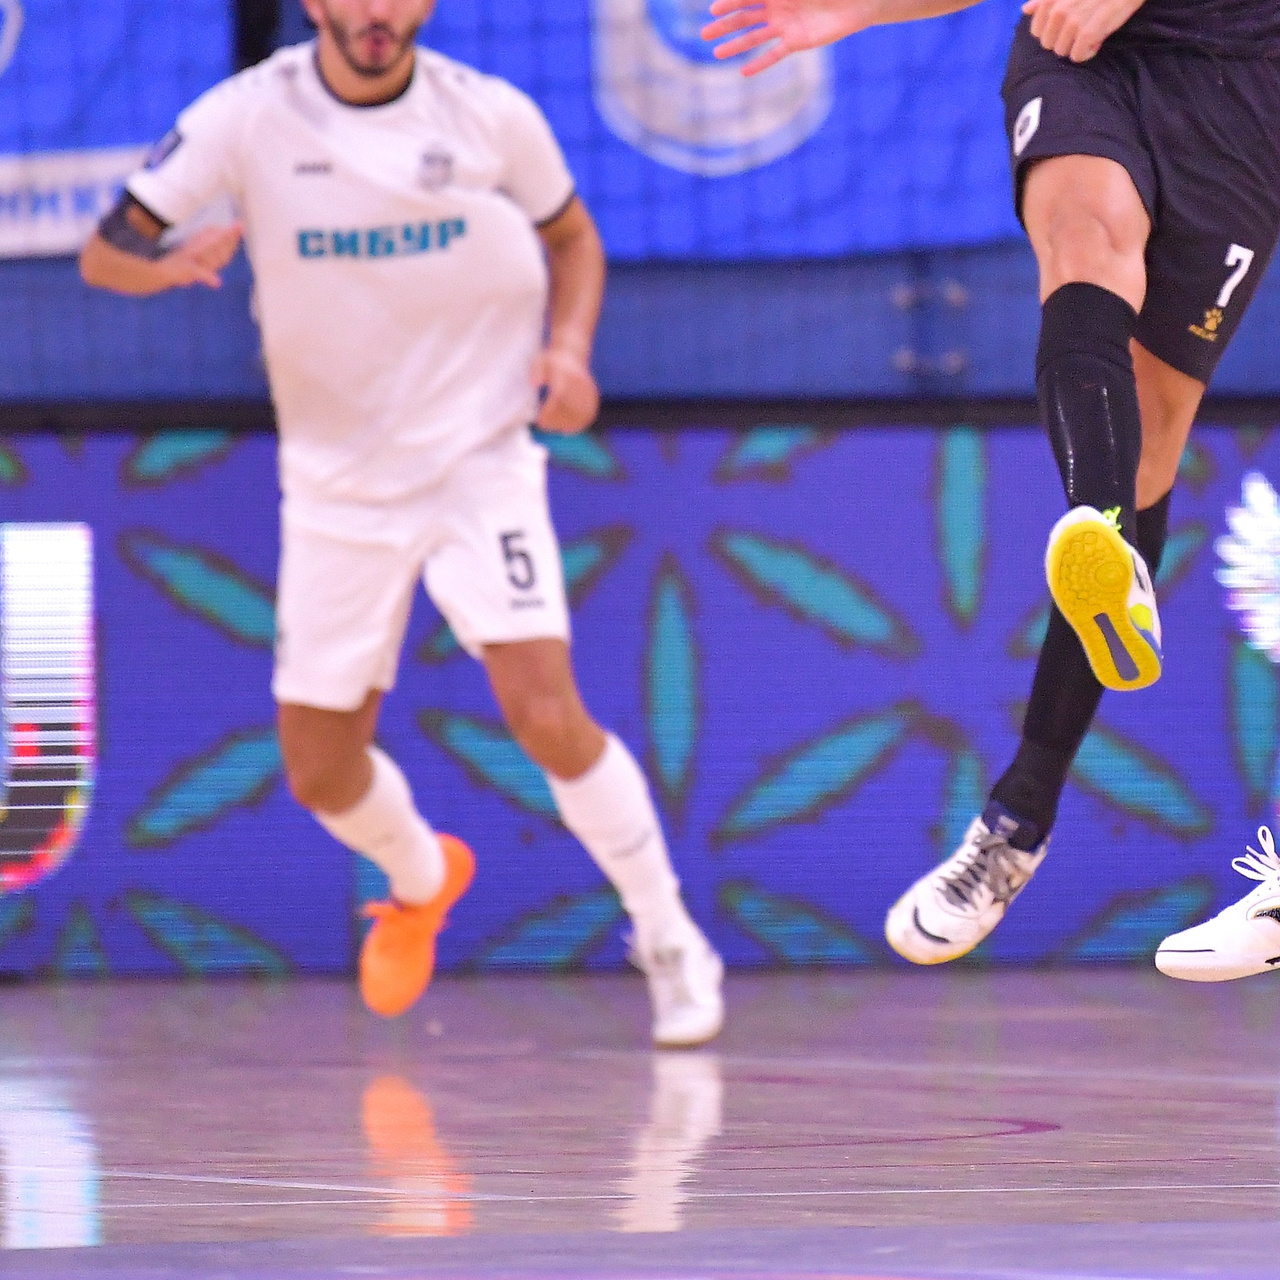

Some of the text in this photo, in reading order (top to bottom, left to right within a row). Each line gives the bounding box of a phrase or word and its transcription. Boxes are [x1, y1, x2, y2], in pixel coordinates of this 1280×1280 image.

[297, 217, 467, 259] СИБУР
[1216, 243, 1255, 309] 7
[499, 528, 536, 590] 5
